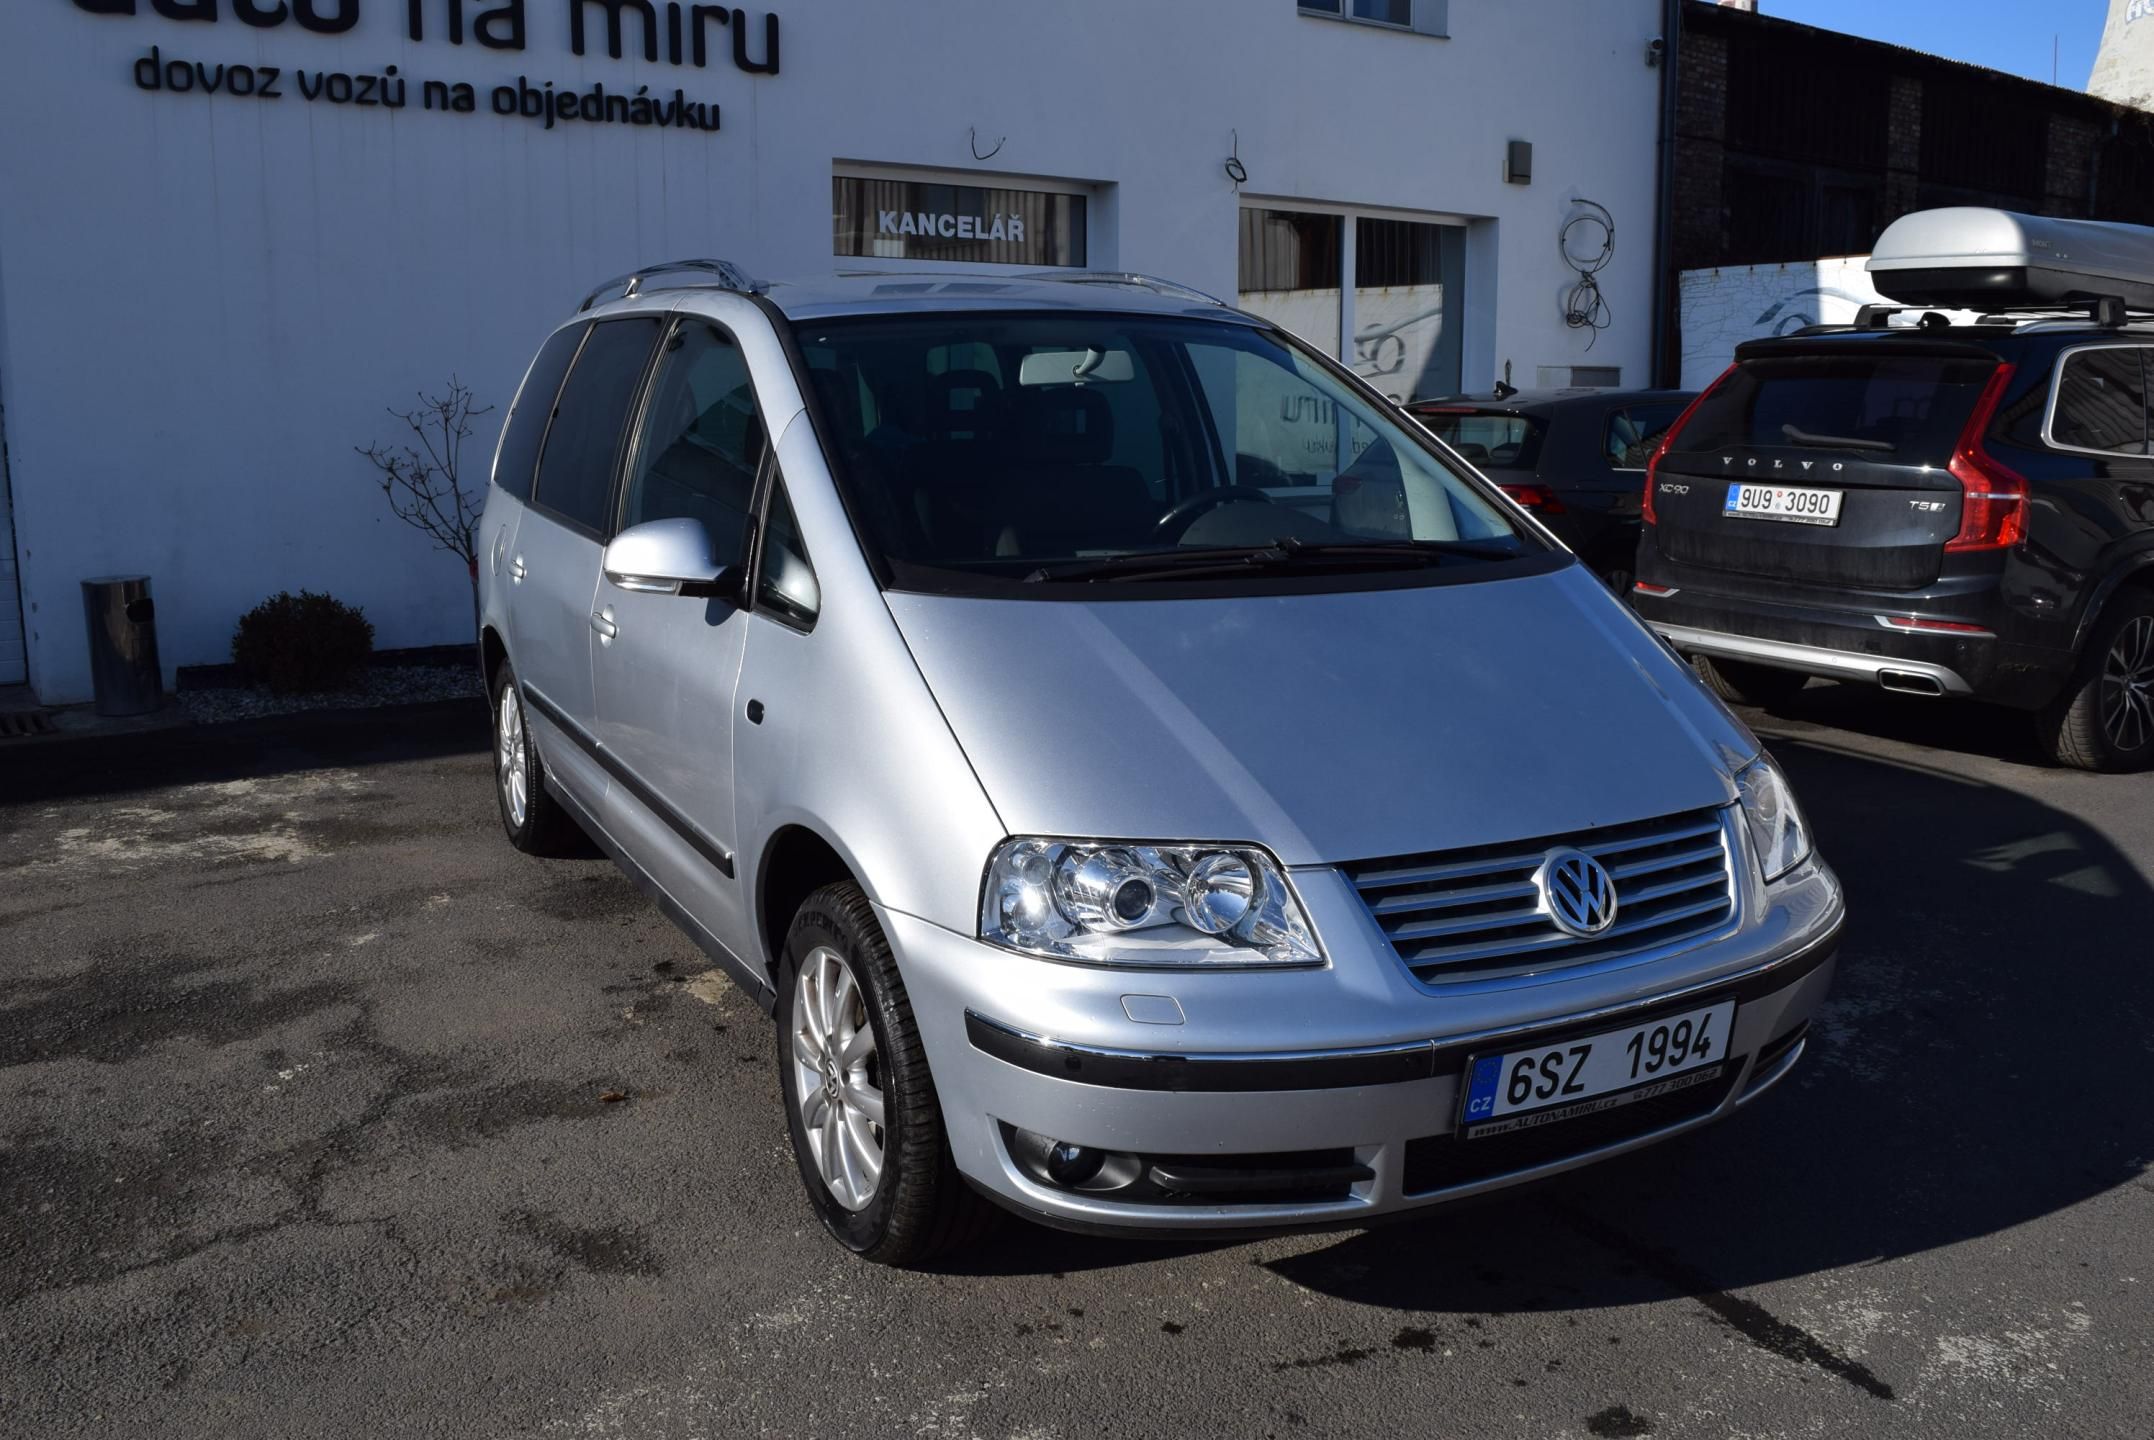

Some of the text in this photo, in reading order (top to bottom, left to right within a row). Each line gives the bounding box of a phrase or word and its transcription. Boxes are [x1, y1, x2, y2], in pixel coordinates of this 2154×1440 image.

[134, 45, 720, 131] dovoz vozů na objednávku
[879, 209, 1025, 242] KANCELÁŘ
[1741, 488, 1773, 509] 9U9
[1785, 491, 1830, 514] 3090
[1470, 1013, 1713, 1113] CZ 6SZ 1994
